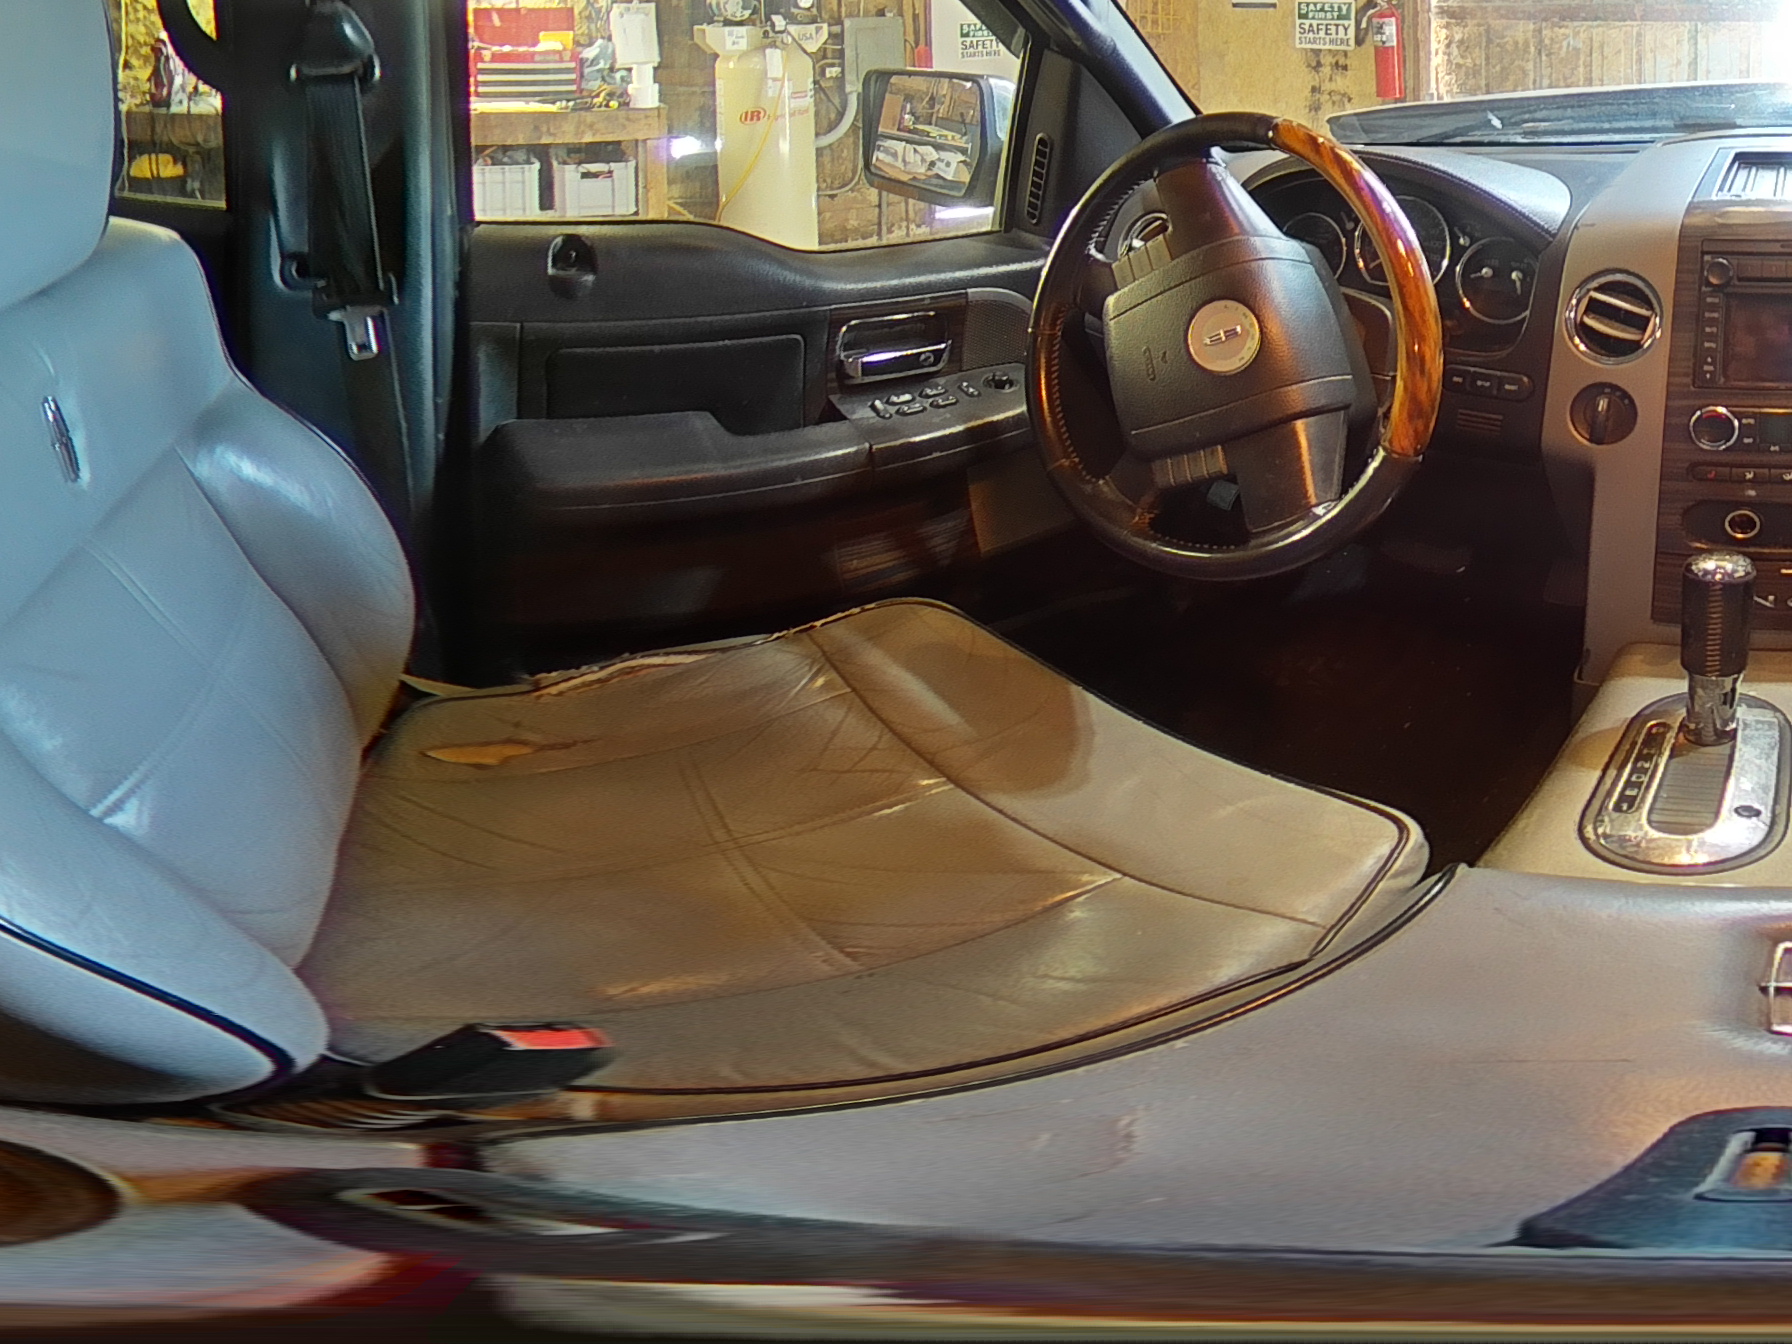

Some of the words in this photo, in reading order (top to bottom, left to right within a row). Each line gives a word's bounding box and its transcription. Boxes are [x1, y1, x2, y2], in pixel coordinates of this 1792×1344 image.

[1300, 3, 1349, 15] SAFETY
[1308, 11, 1339, 19] FIRST
[1298, 22, 1351, 36] SAFETY
[797, 33, 814, 42] USA
[1298, 36, 1327, 46] STARTS
[1328, 37, 1351, 47] HERE
